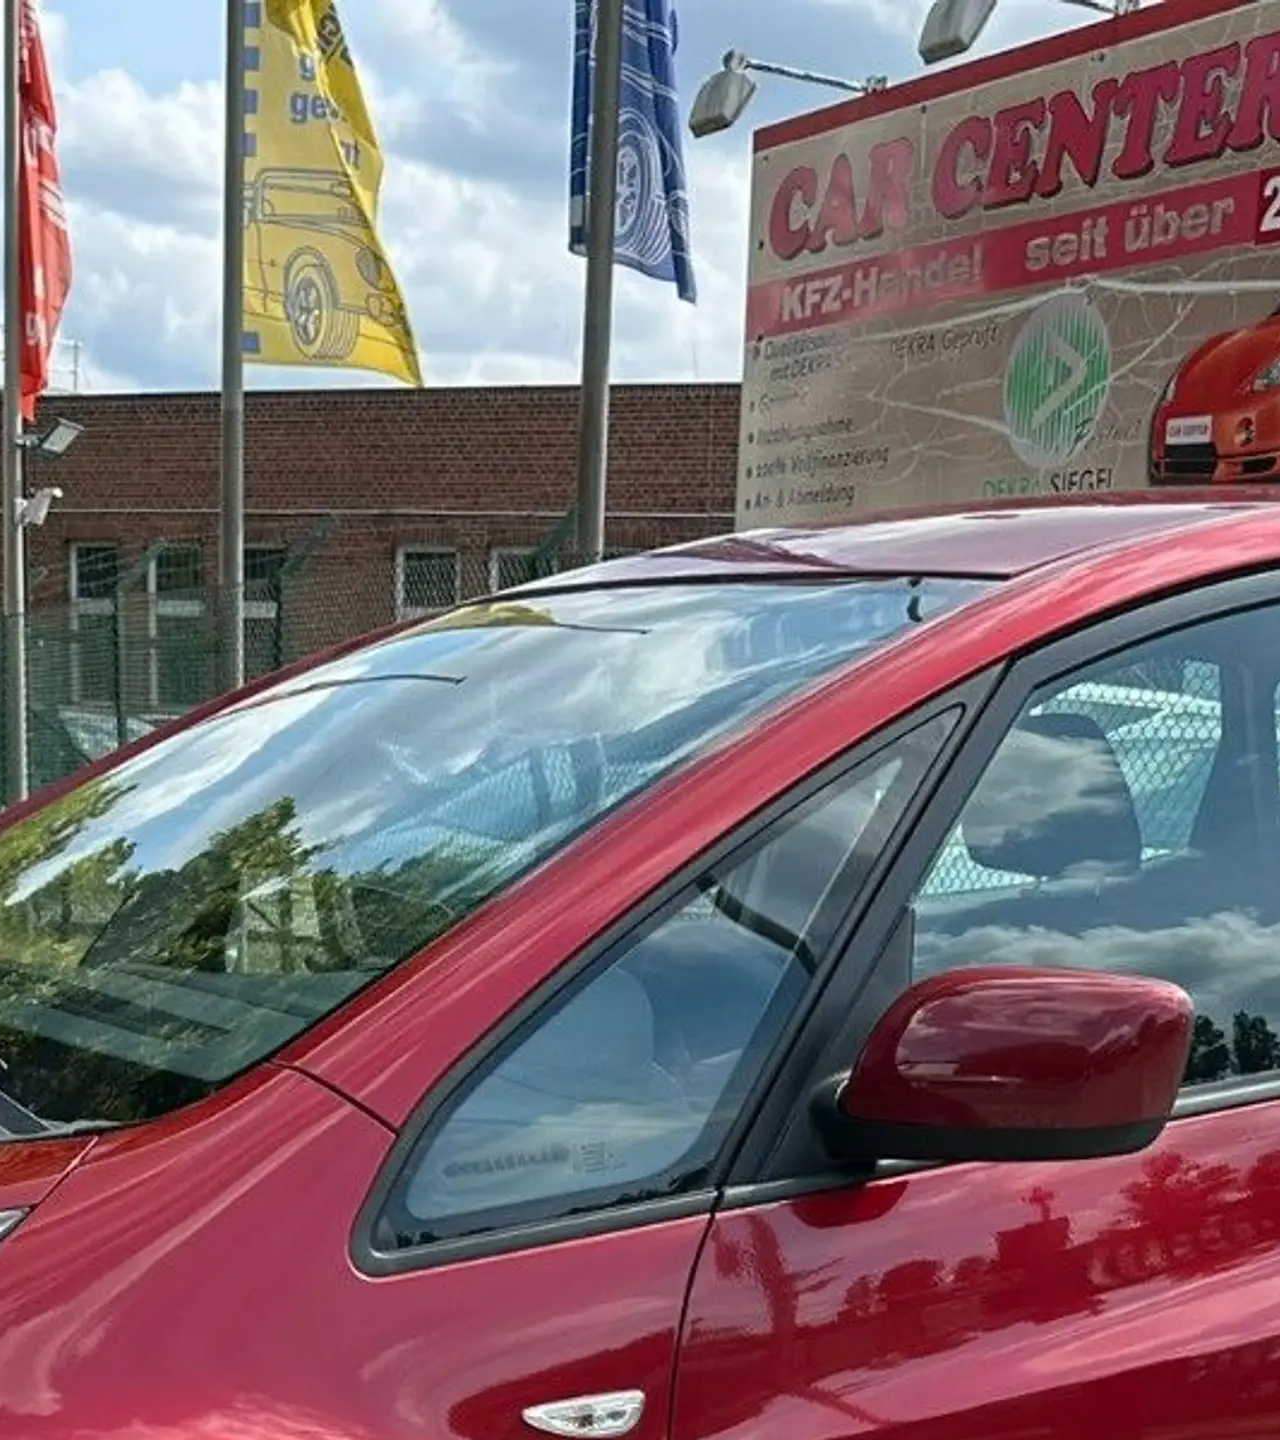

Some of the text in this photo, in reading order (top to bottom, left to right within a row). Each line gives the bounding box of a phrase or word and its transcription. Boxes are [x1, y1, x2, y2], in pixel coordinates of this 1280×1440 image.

[770, 136, 915, 261] CAR
[781, 241, 985, 323] KFZ-Handel
[1023, 215, 1110, 272] seit
[1124, 197, 1236, 253] über
